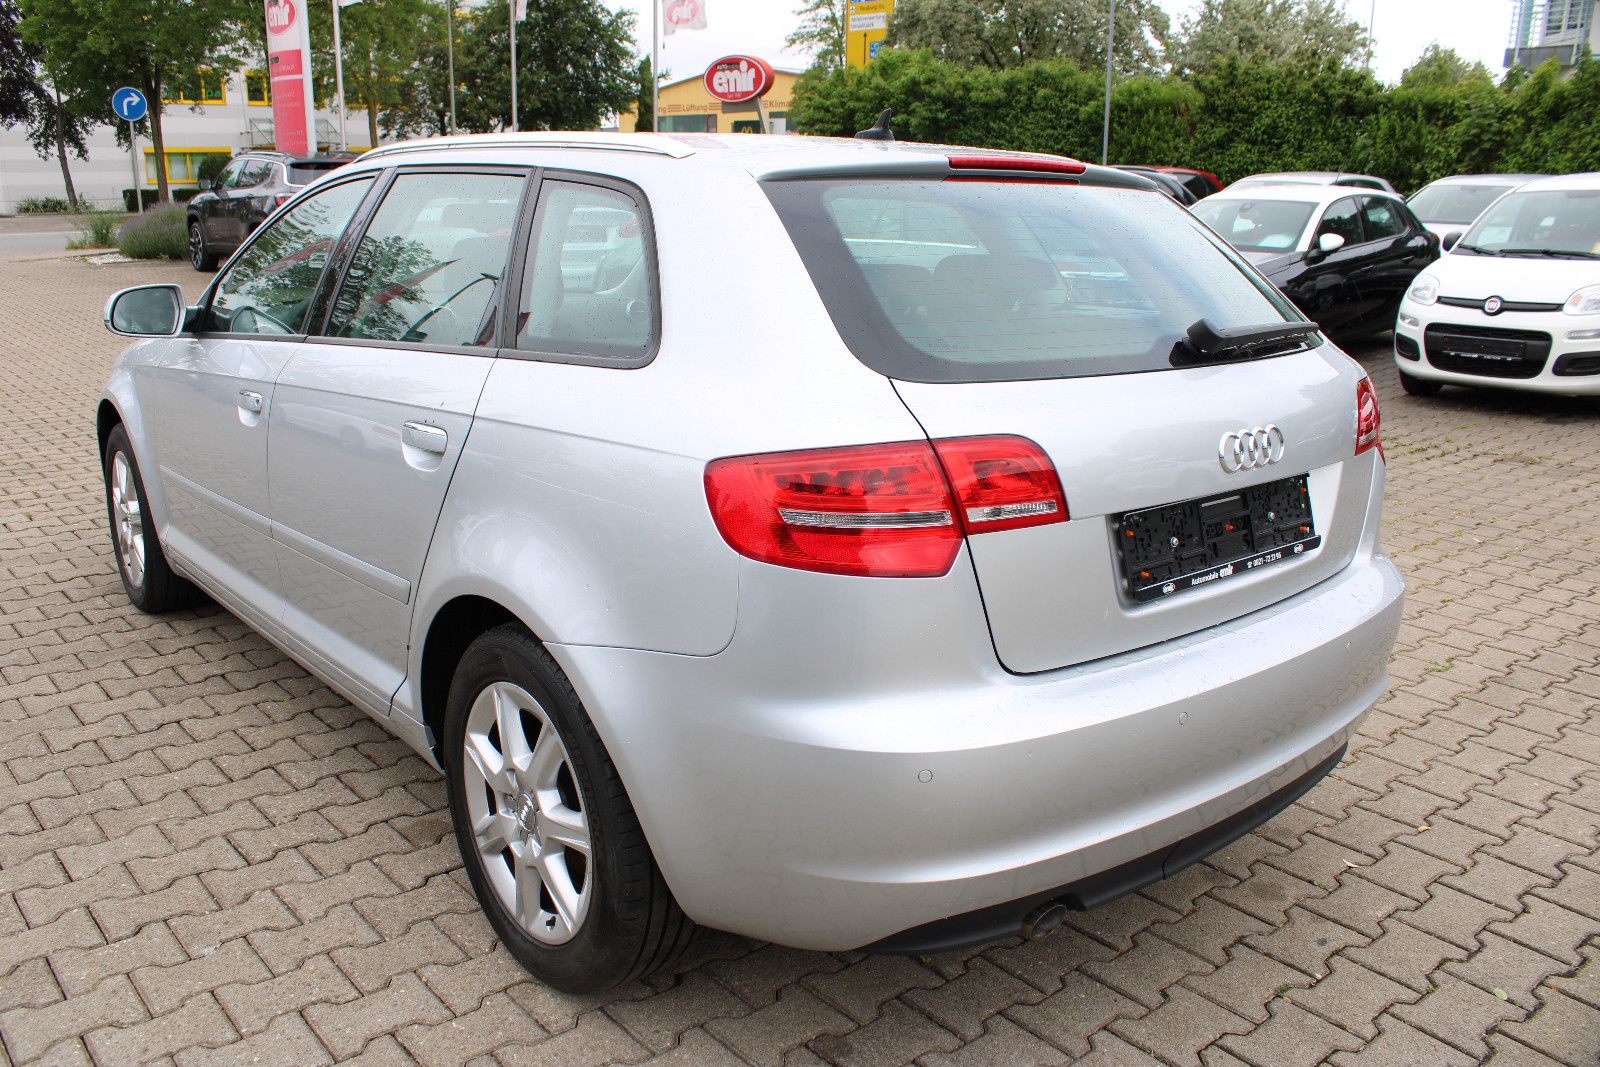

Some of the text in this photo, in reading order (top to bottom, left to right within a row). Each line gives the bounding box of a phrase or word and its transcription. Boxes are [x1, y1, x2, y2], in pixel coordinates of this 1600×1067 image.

[712, 60, 756, 93] emir
[682, 103, 708, 113] Lüftung
[1191, 571, 1219, 586] Automobile
[1219, 562, 1234, 578] emir
